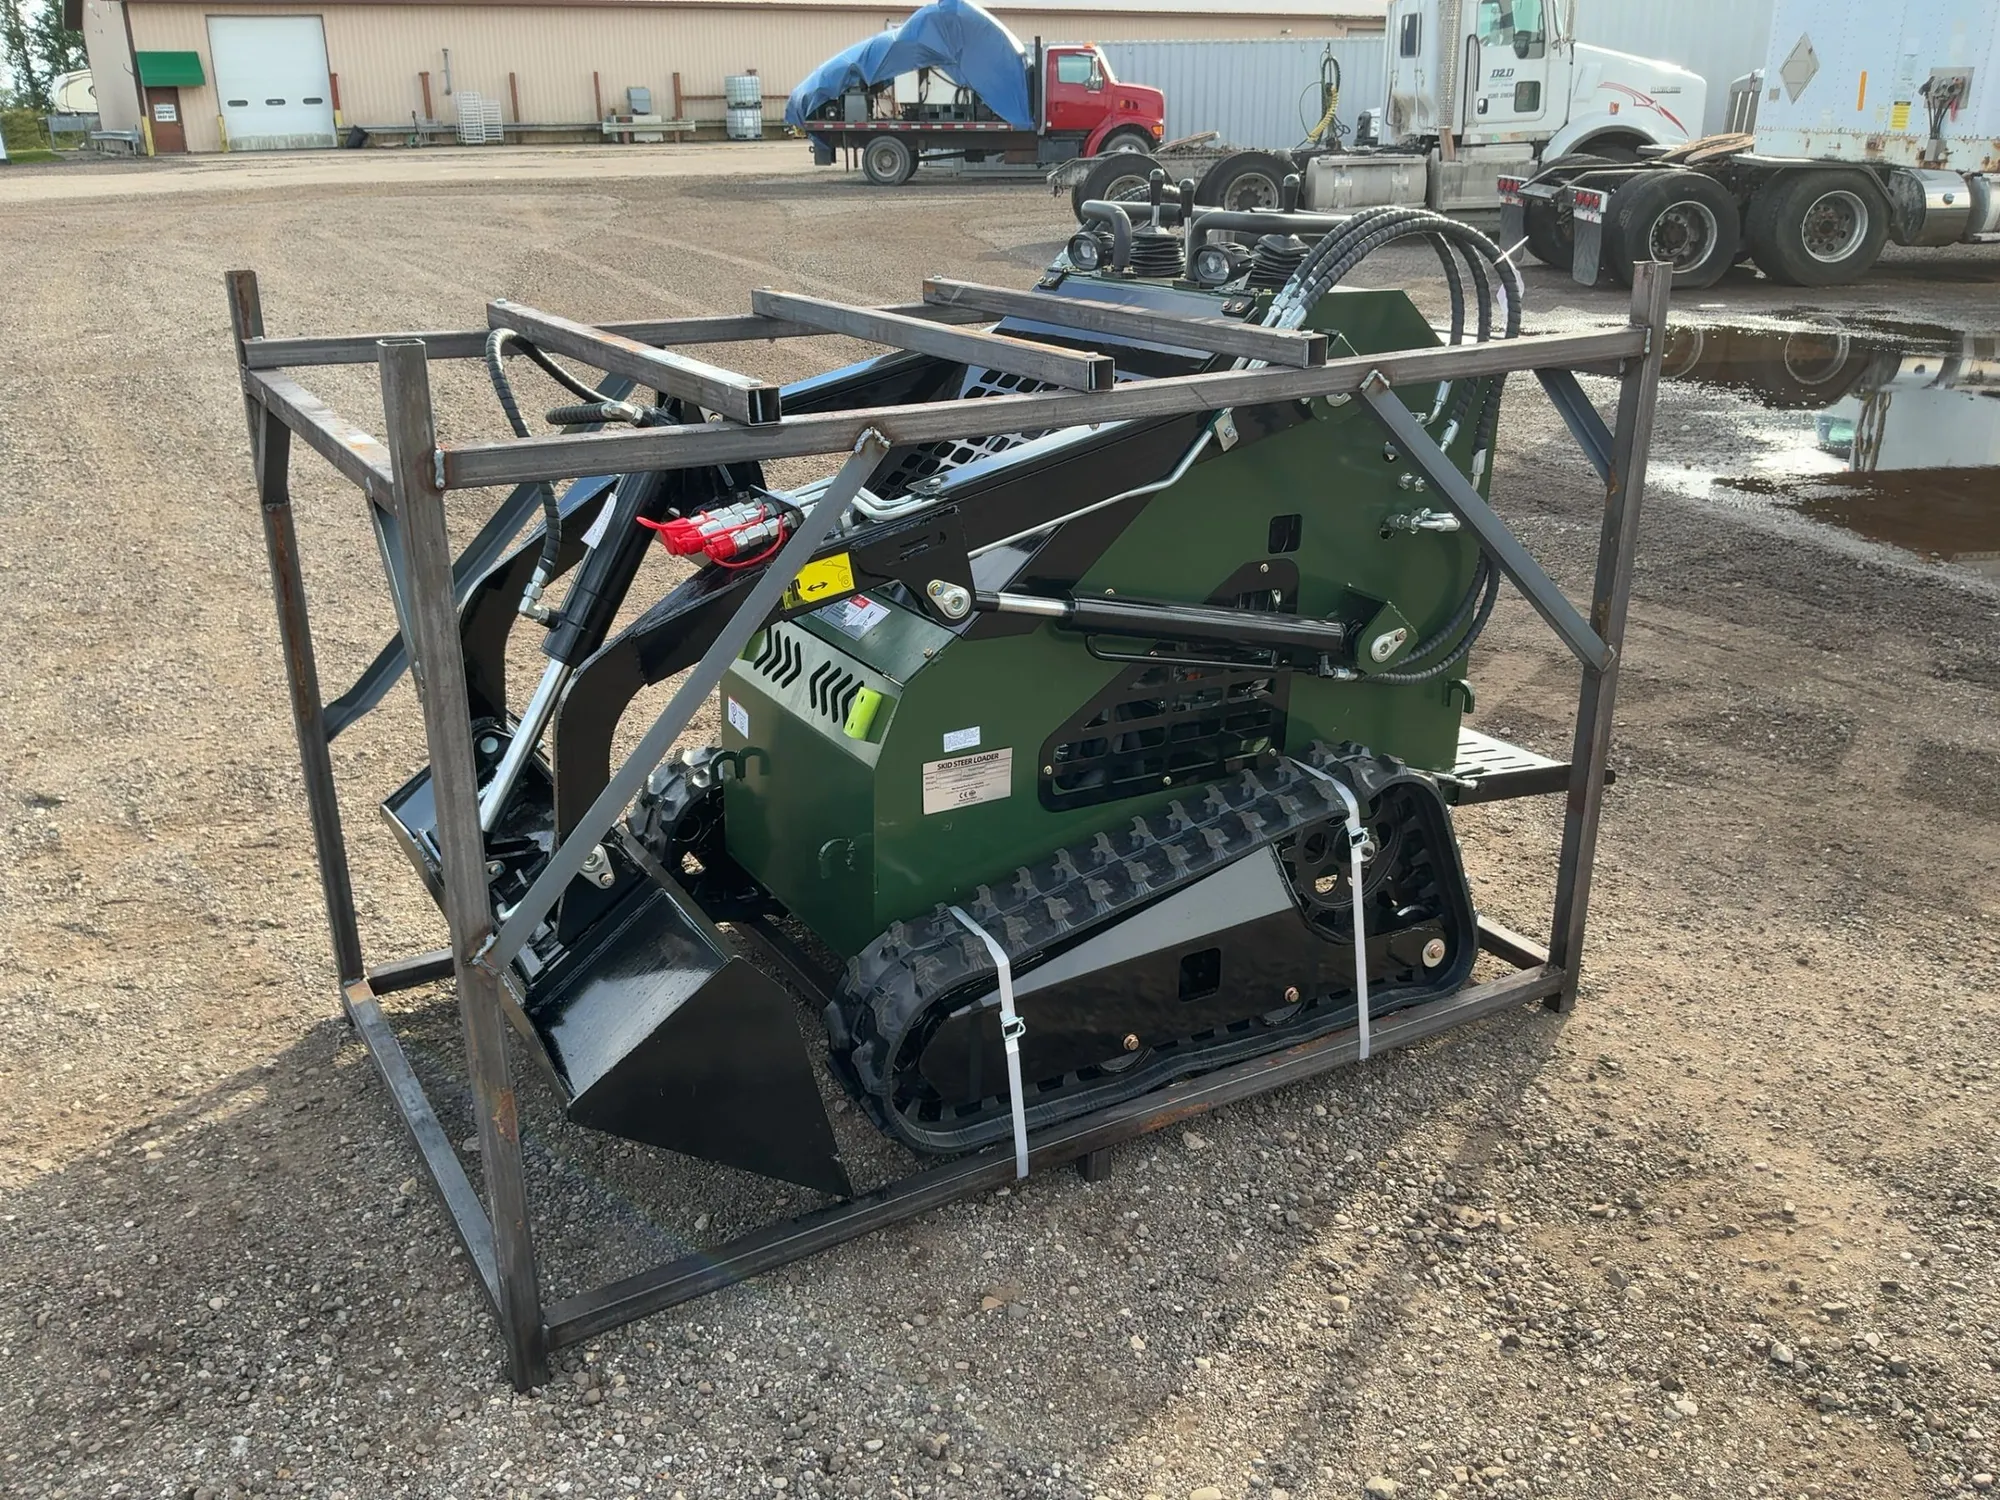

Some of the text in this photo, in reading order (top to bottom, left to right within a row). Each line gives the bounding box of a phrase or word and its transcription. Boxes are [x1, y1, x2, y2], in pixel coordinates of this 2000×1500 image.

[1490, 68, 1514, 78] D2D
[937, 753, 999, 770] SKID STEER LOADER
